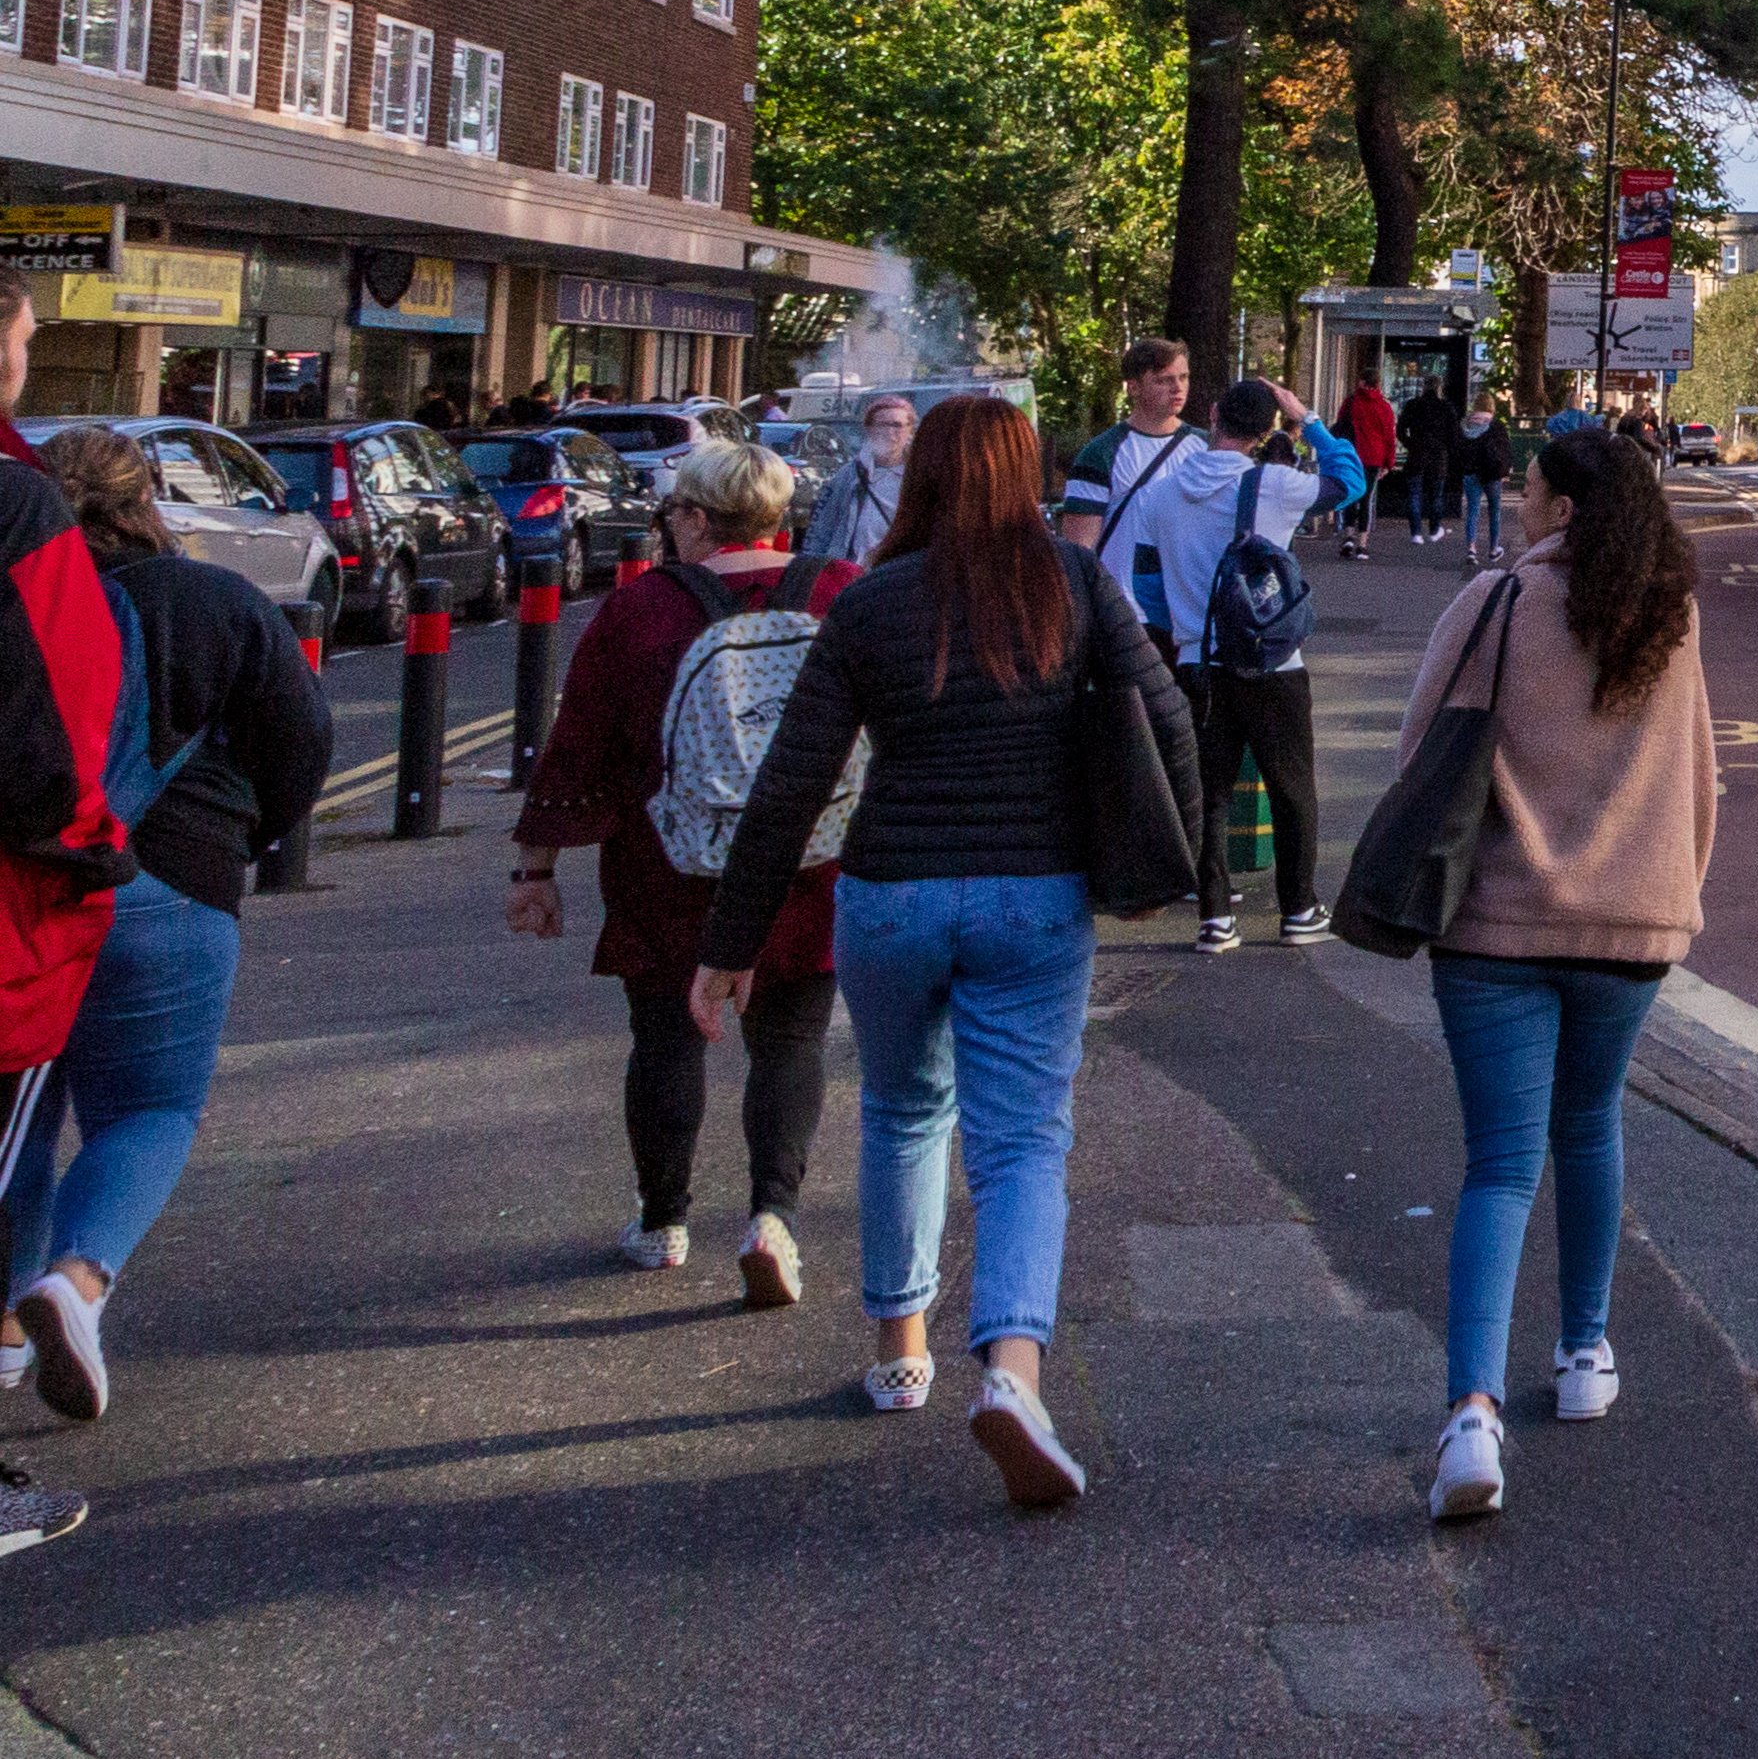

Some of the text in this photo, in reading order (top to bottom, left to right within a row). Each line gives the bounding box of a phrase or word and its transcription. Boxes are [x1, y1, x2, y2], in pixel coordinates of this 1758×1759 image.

[23, 234, 70, 248] OFF
[7, 254, 95, 270] ICENCE
[579, 281, 654, 324] OCEAN
